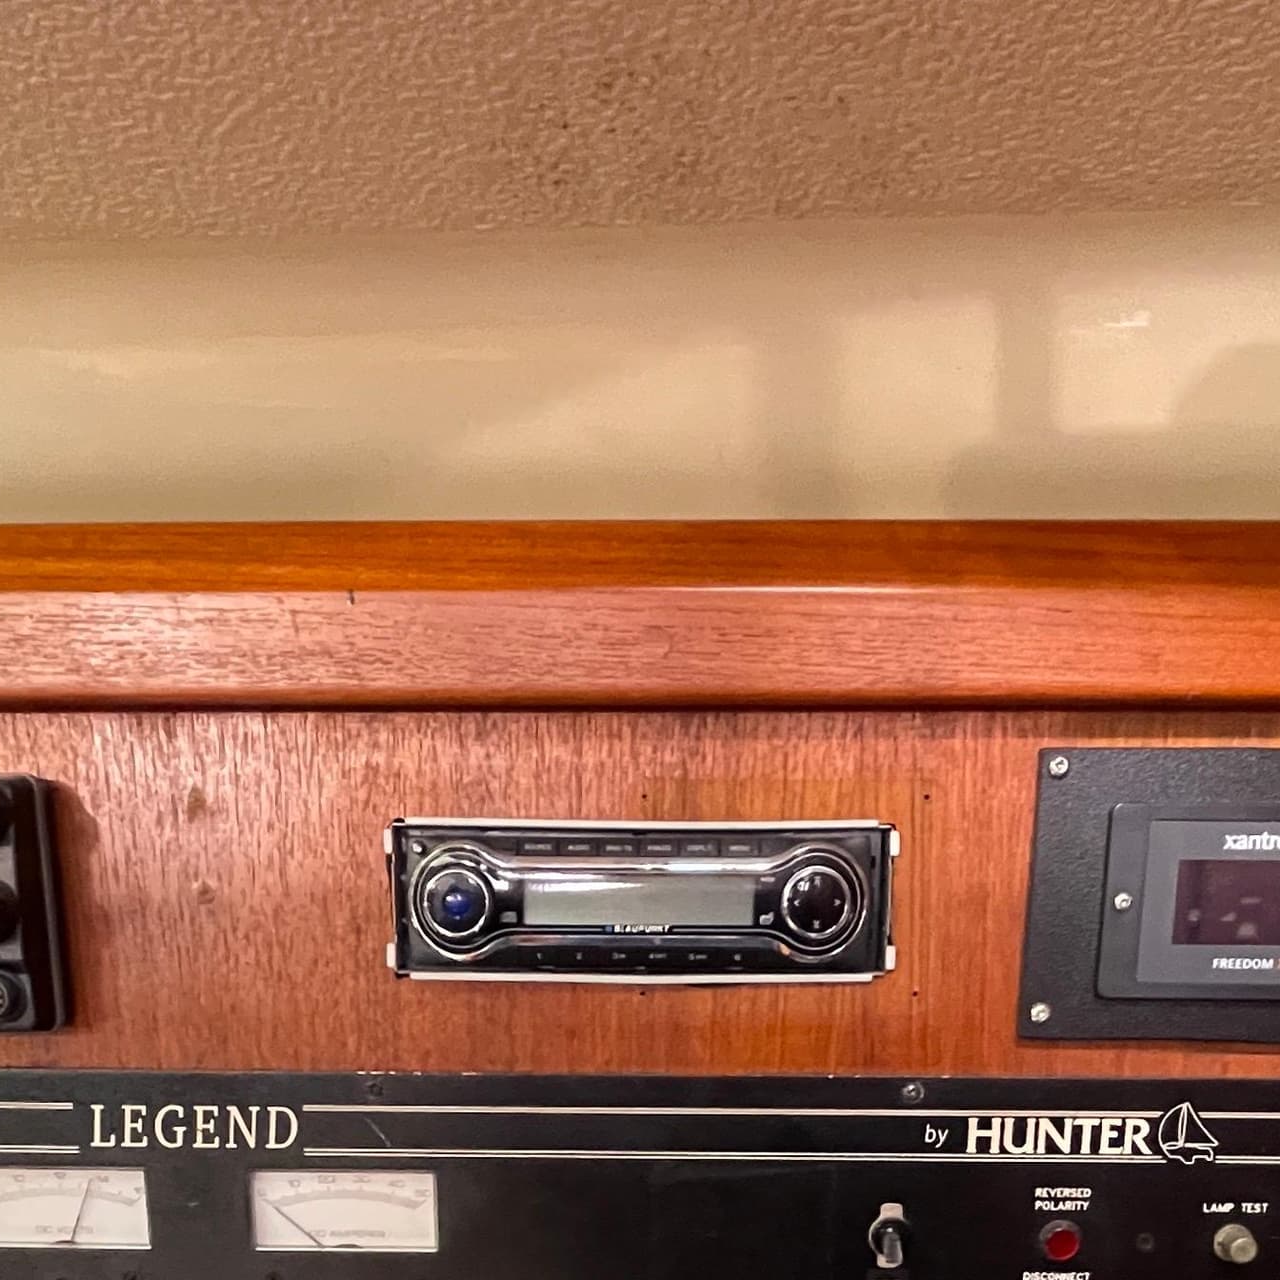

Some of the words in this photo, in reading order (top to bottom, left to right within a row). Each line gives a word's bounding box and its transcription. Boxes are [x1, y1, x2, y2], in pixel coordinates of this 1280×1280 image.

[1212, 957, 1274, 970] FREEDOM
[89, 1103, 300, 1151] LEGEND
[924, 1124, 950, 1149] by
[965, 1116, 1154, 1155] HUNTER
[1034, 1187, 1092, 1198] REVERSED
[1034, 1201, 1090, 1212] POLARITY
[1203, 1202, 1235, 1213] LAMP
[1241, 1202, 1269, 1213] TEST
